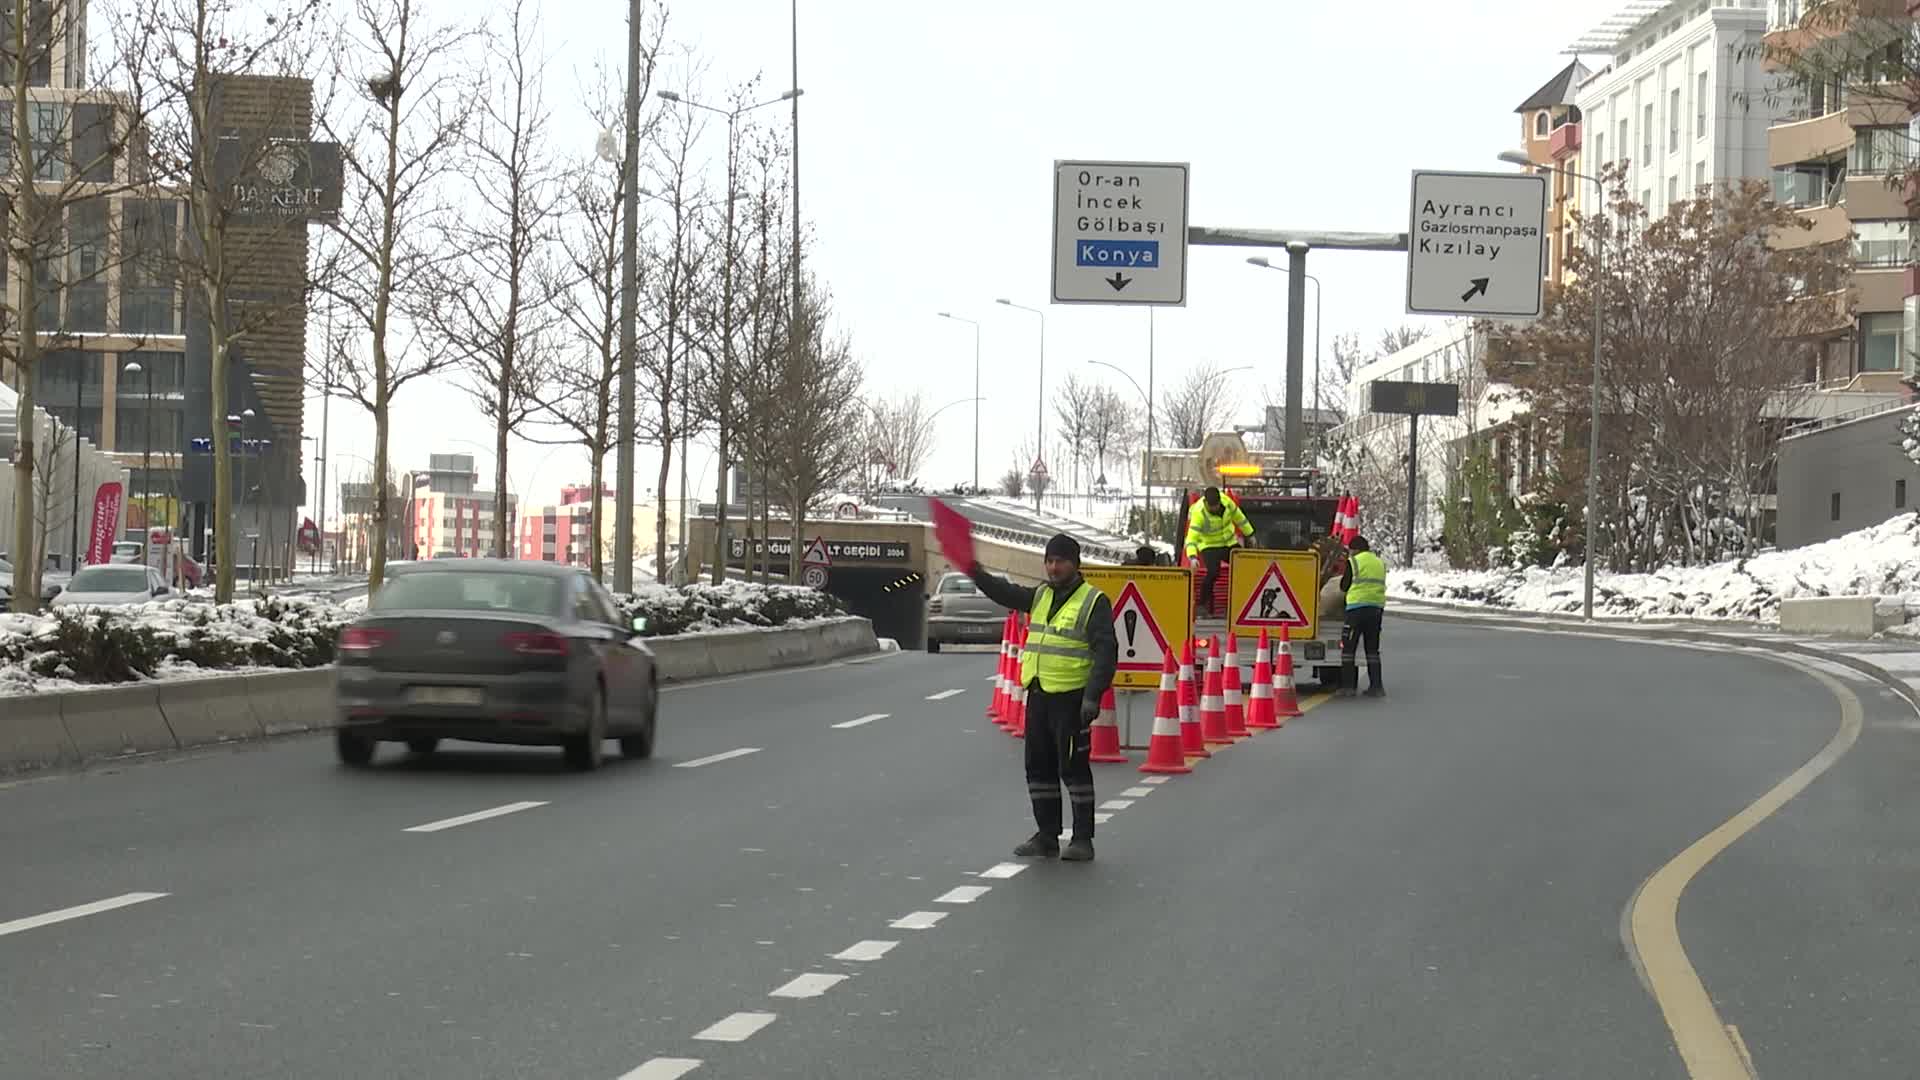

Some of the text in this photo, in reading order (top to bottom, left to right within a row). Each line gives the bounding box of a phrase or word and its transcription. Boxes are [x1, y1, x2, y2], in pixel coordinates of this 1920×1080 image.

[1078, 170, 1140, 187] Or-an
[1077, 190, 1142, 209] İncek
[1422, 200, 1513, 219] Ayrancı
[1077, 216, 1164, 234] Gölbaşı
[1420, 220, 1537, 238] Gaziosmanpaşa
[1082, 245, 1153, 265] Konya
[1419, 238, 1500, 260] Kızılay
[843, 544, 881, 558] GEÇİDİ
